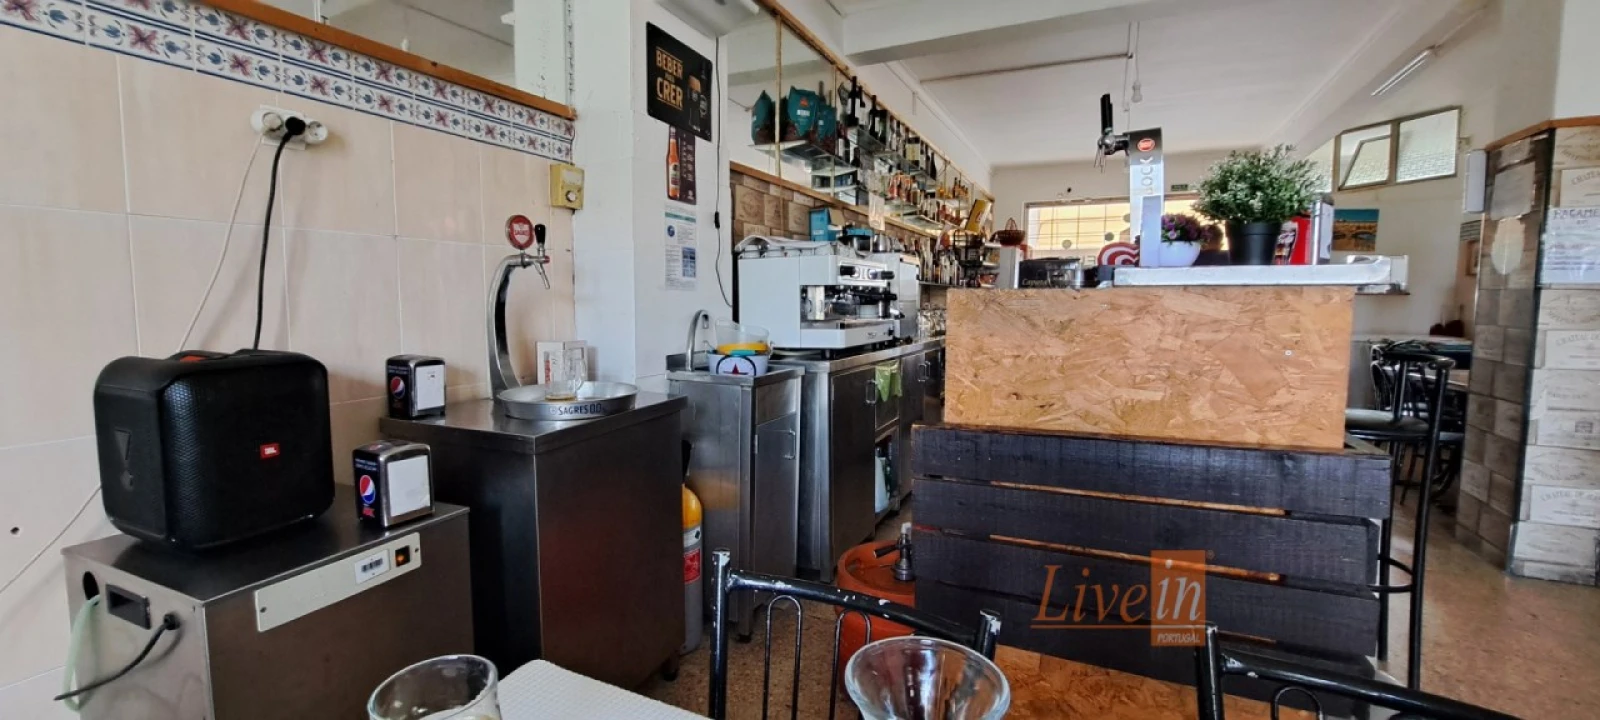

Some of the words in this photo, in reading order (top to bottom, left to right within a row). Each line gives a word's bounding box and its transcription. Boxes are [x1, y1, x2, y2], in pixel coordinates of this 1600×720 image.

[656, 50, 683, 79] BEBER
[657, 77, 684, 109] CRER
[558, 404, 588, 415] SAGRES
